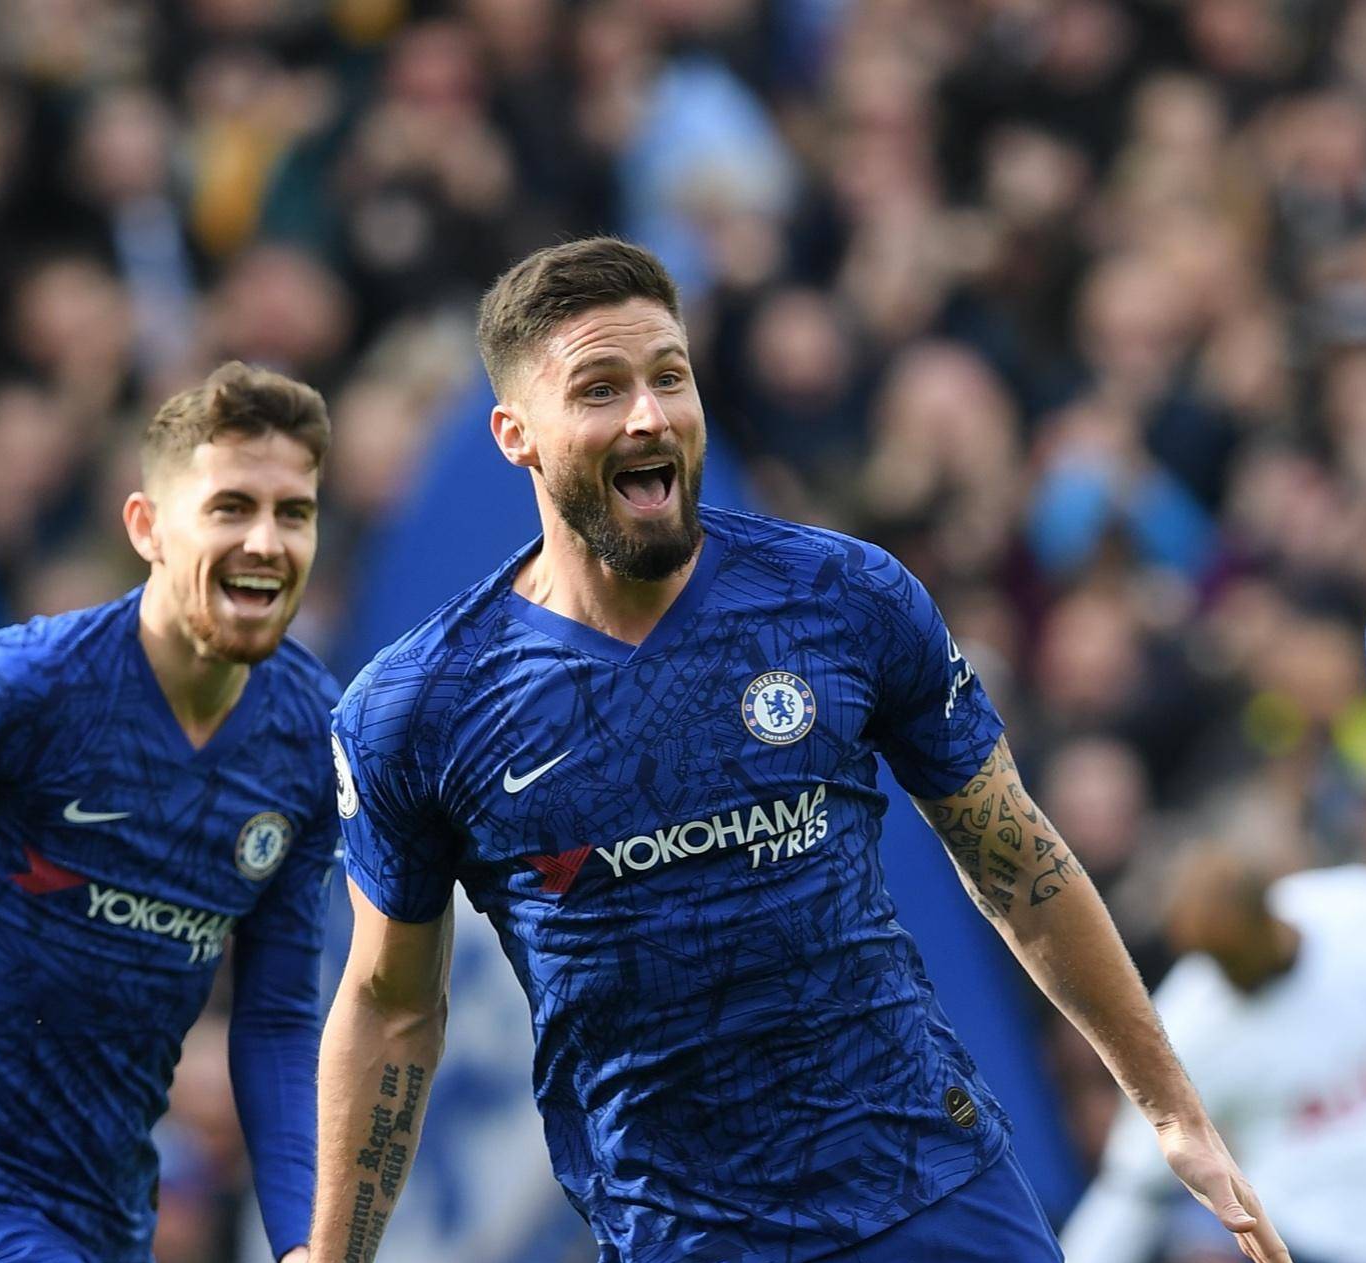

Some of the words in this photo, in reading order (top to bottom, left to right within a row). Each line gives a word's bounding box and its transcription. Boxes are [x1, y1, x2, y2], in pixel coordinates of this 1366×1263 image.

[750, 674, 796, 695] CHELSEA
[595, 783, 826, 878] YOKOHAMA
[748, 809, 828, 869] TYRES
